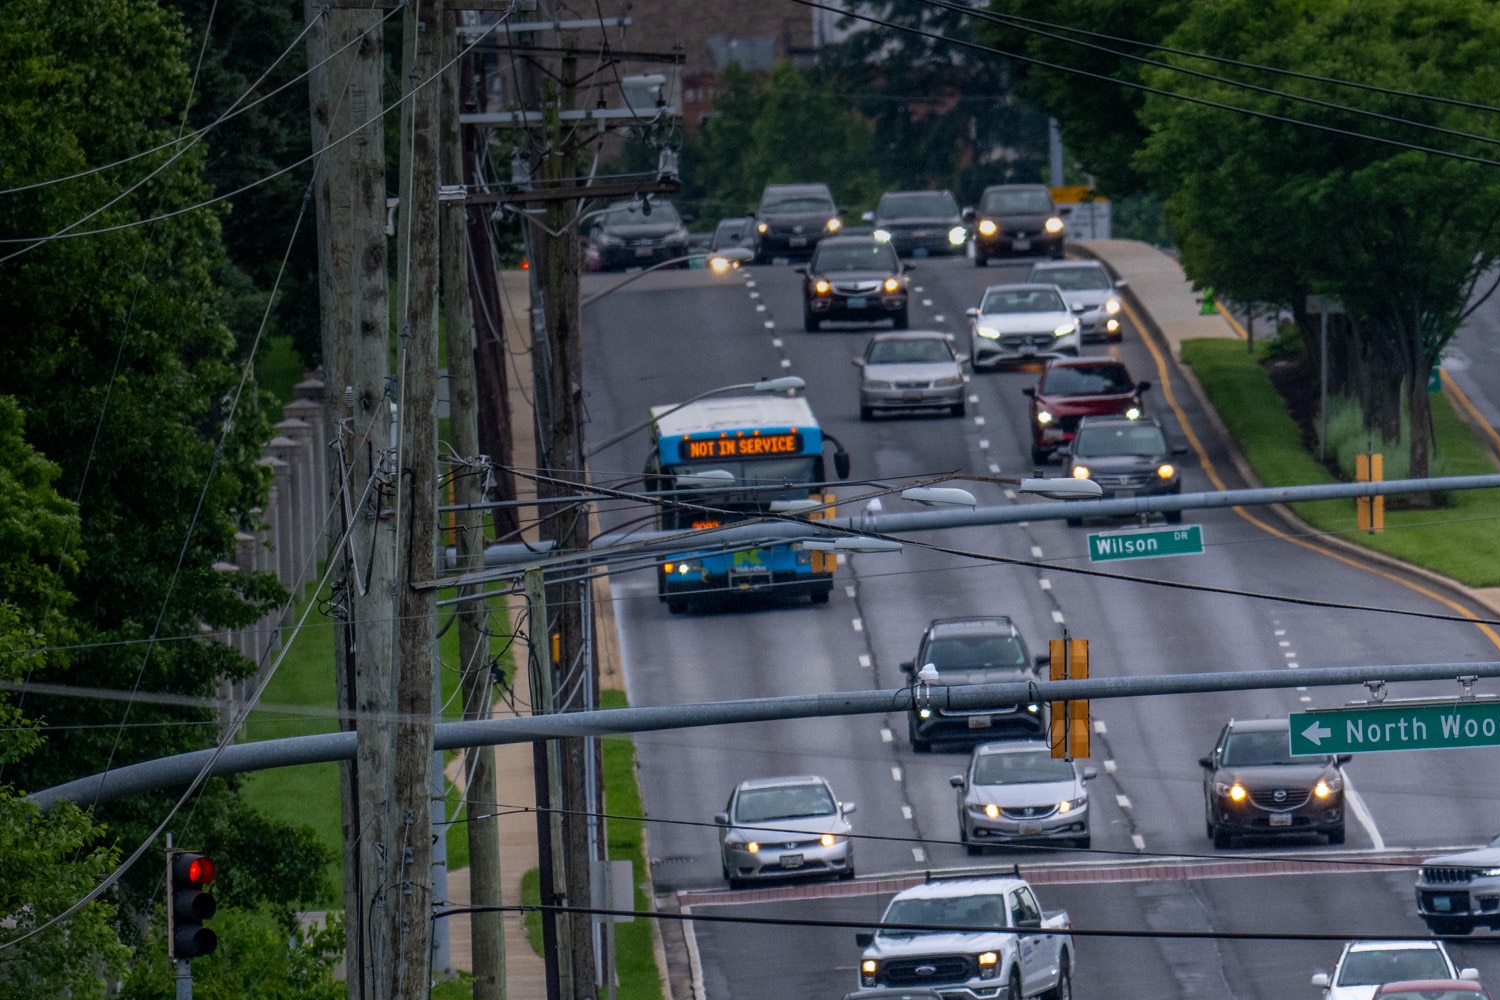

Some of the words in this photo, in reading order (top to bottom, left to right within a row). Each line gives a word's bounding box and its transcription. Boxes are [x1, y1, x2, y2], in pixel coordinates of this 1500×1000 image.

[690, 441, 714, 458] NOT
[718, 439, 735, 455] IN
[738, 435, 796, 454] SERVICE
[1096, 538, 1158, 556] Wilson
[1174, 531, 1188, 540] DR
[1346, 717, 1427, 744] North
